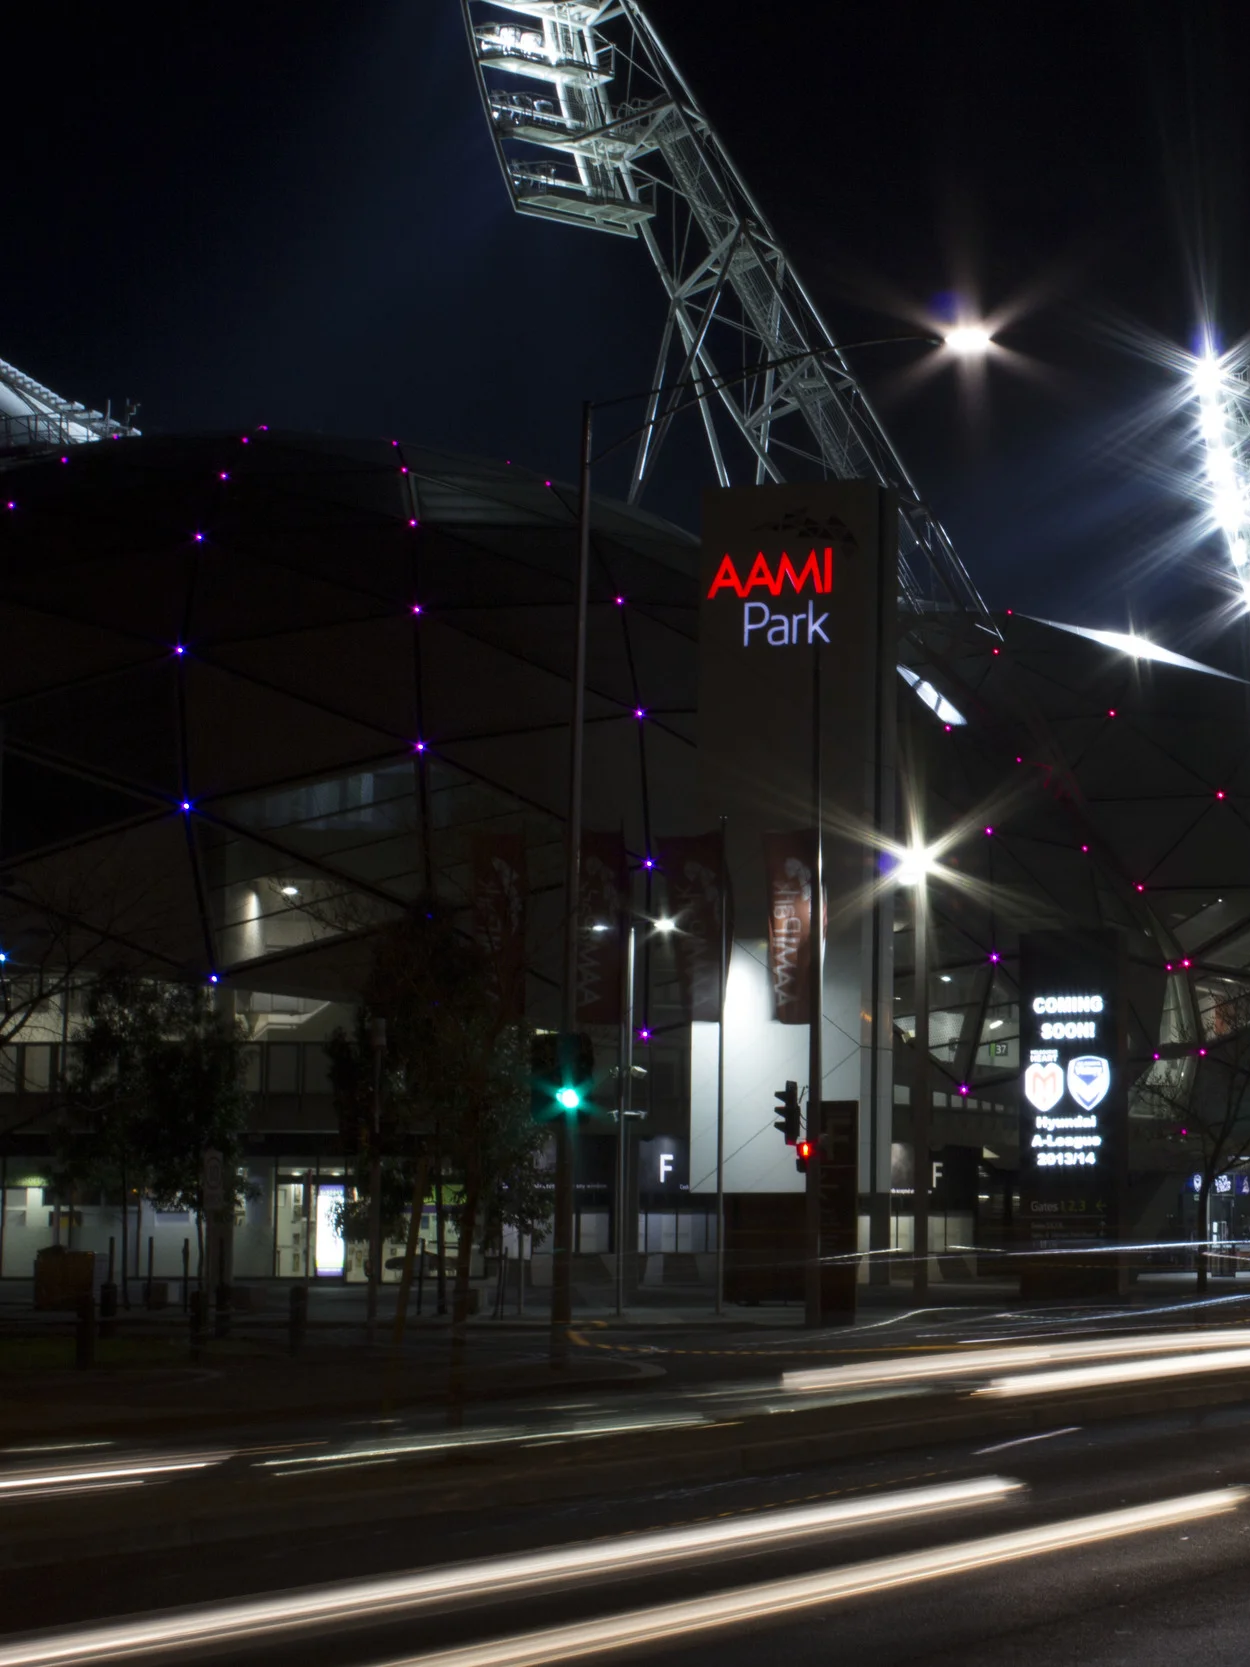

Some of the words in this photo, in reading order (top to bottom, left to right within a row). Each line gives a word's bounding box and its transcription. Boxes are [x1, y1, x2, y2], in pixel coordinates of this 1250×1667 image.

[707, 547, 833, 600] AAMI
[743, 600, 831, 648] Park
[1032, 995, 1105, 1014] COMING
[1040, 1021, 1096, 1040] SOON!
[1036, 1114, 1097, 1132] Hyundai
[1031, 1134, 1102, 1151] A-League
[1036, 1151, 1096, 1167] 2013/14
[1030, 1200, 1059, 1212] Gates
